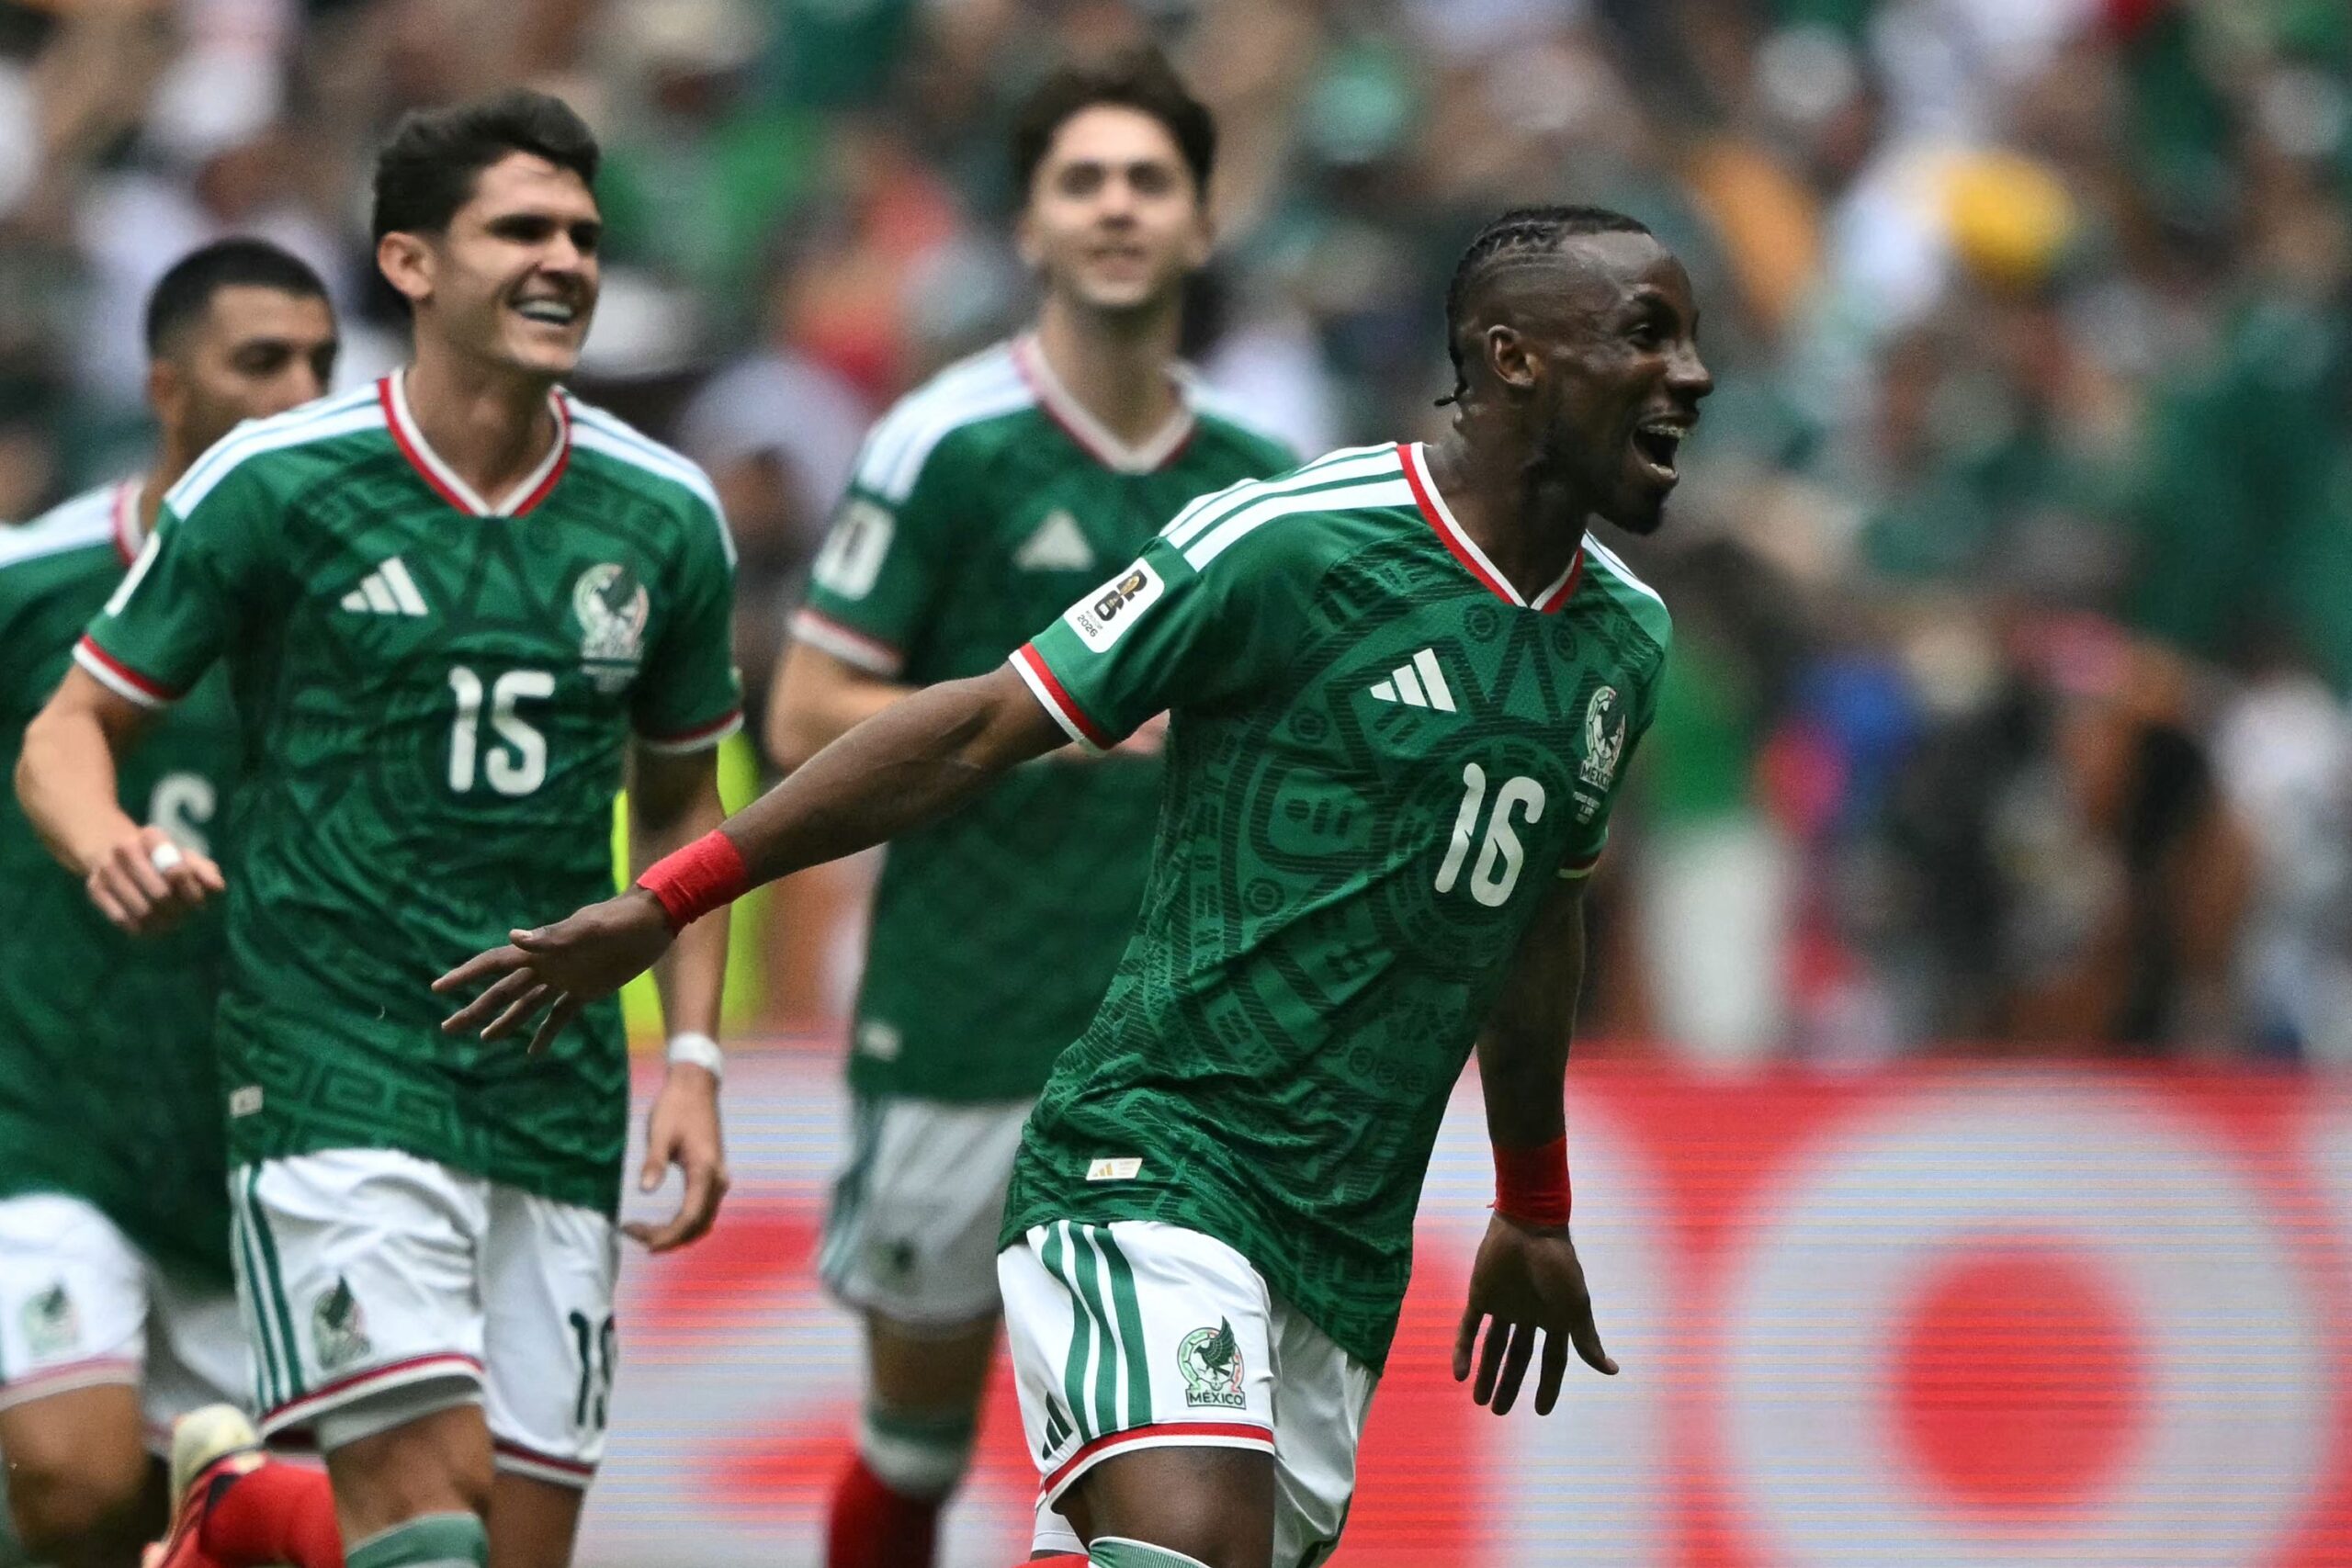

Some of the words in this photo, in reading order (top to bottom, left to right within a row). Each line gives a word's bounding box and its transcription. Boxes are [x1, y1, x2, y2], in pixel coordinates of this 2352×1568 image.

[1077, 615, 1098, 637] 2026
[448, 665, 555, 795] 15
[1435, 762, 1545, 907] 16
[1189, 1389, 1243, 1405] MÉXICO
